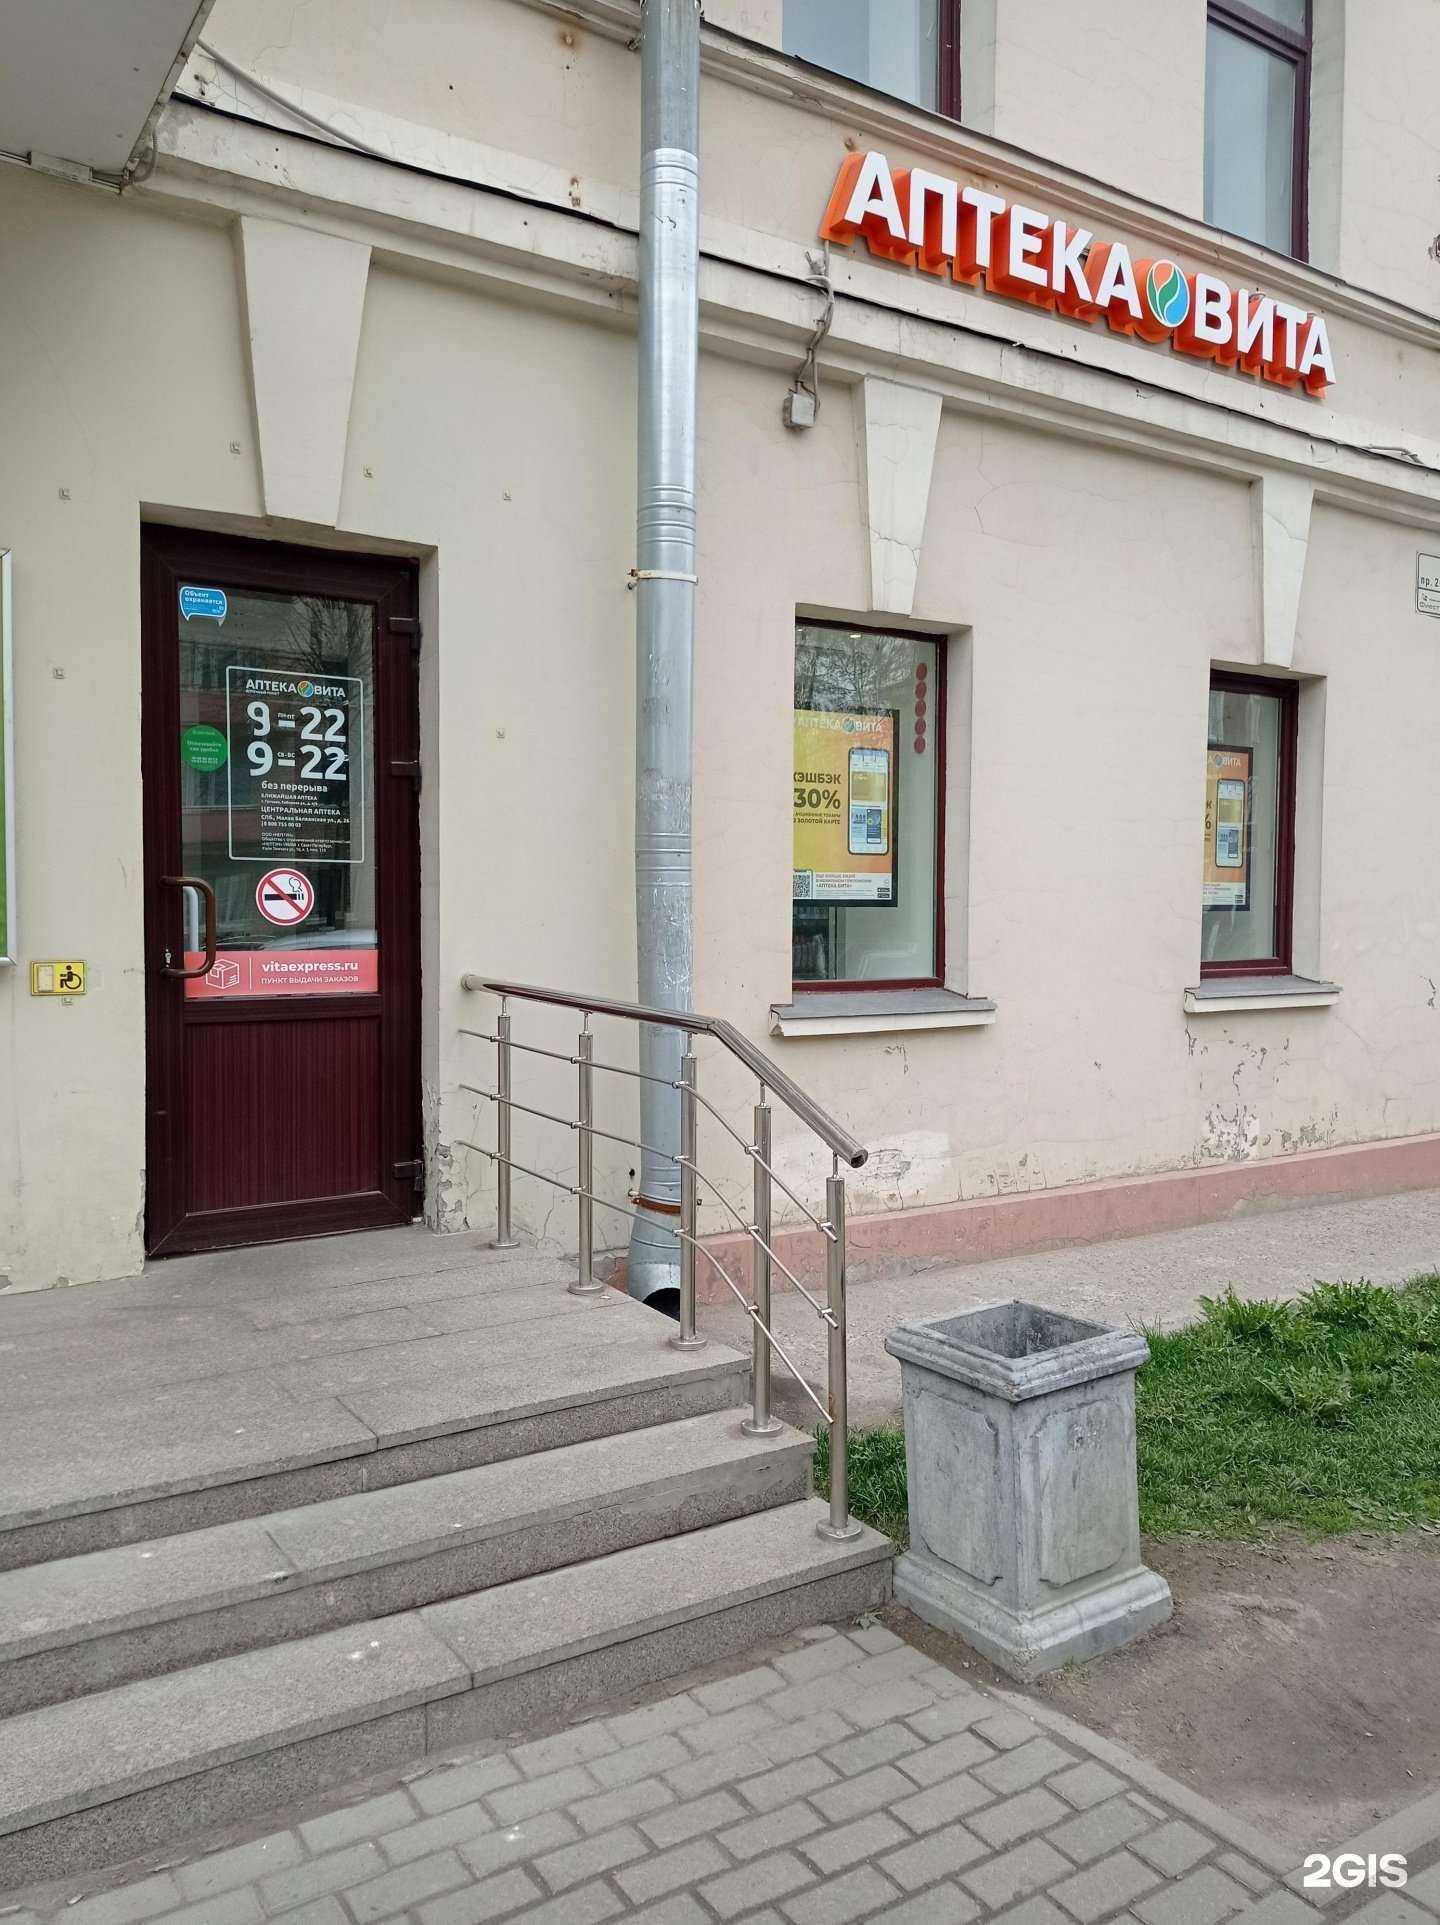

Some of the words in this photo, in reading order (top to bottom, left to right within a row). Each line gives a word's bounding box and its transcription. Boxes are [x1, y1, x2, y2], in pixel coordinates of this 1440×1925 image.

[845, 151, 1143, 319] АПТЕКА
[1195, 273, 1336, 385] ВИТА
[245, 679, 297, 693] АПТЕКА
[314, 685, 346, 698] ВИТА
[854, 719, 882, 733] ВИТА
[261, 780, 278, 790] без
[280, 783, 328, 793] перерыва
[793, 788, 841, 809] 30%
[261, 806, 313, 815] ЦЕНТРАЛЬНАЯ
[262, 960, 358, 974] vitaexpress.ru
[261, 976, 288, 985] ПУНКТ
[289, 976, 323, 985] ВЫДАЧИ
[325, 975, 360, 984] ЗАКАЗОВ
